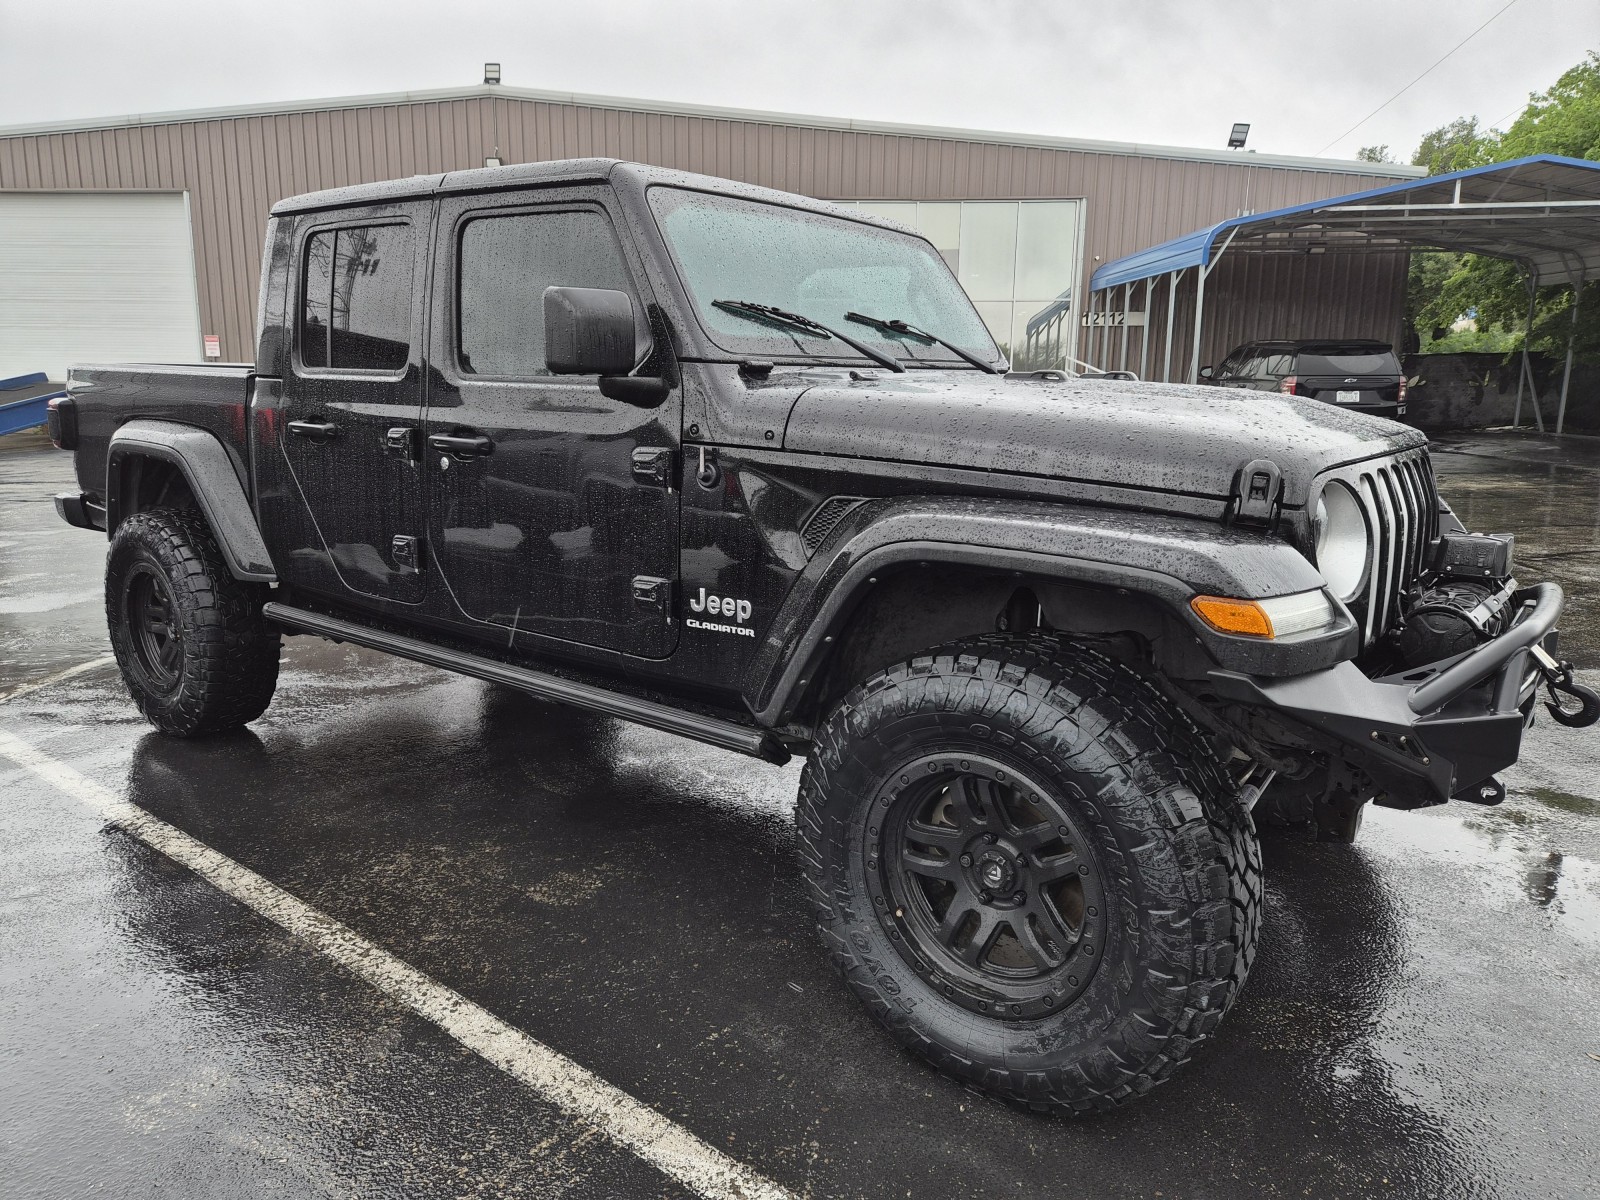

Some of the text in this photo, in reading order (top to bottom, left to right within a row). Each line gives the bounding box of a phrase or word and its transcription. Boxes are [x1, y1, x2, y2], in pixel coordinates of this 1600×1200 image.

[1082, 312, 1125, 325] 12112
[690, 588, 752, 623] Jeep
[686, 619, 755, 637] GLADIATOR
[850, 930, 917, 1014] TOYO
